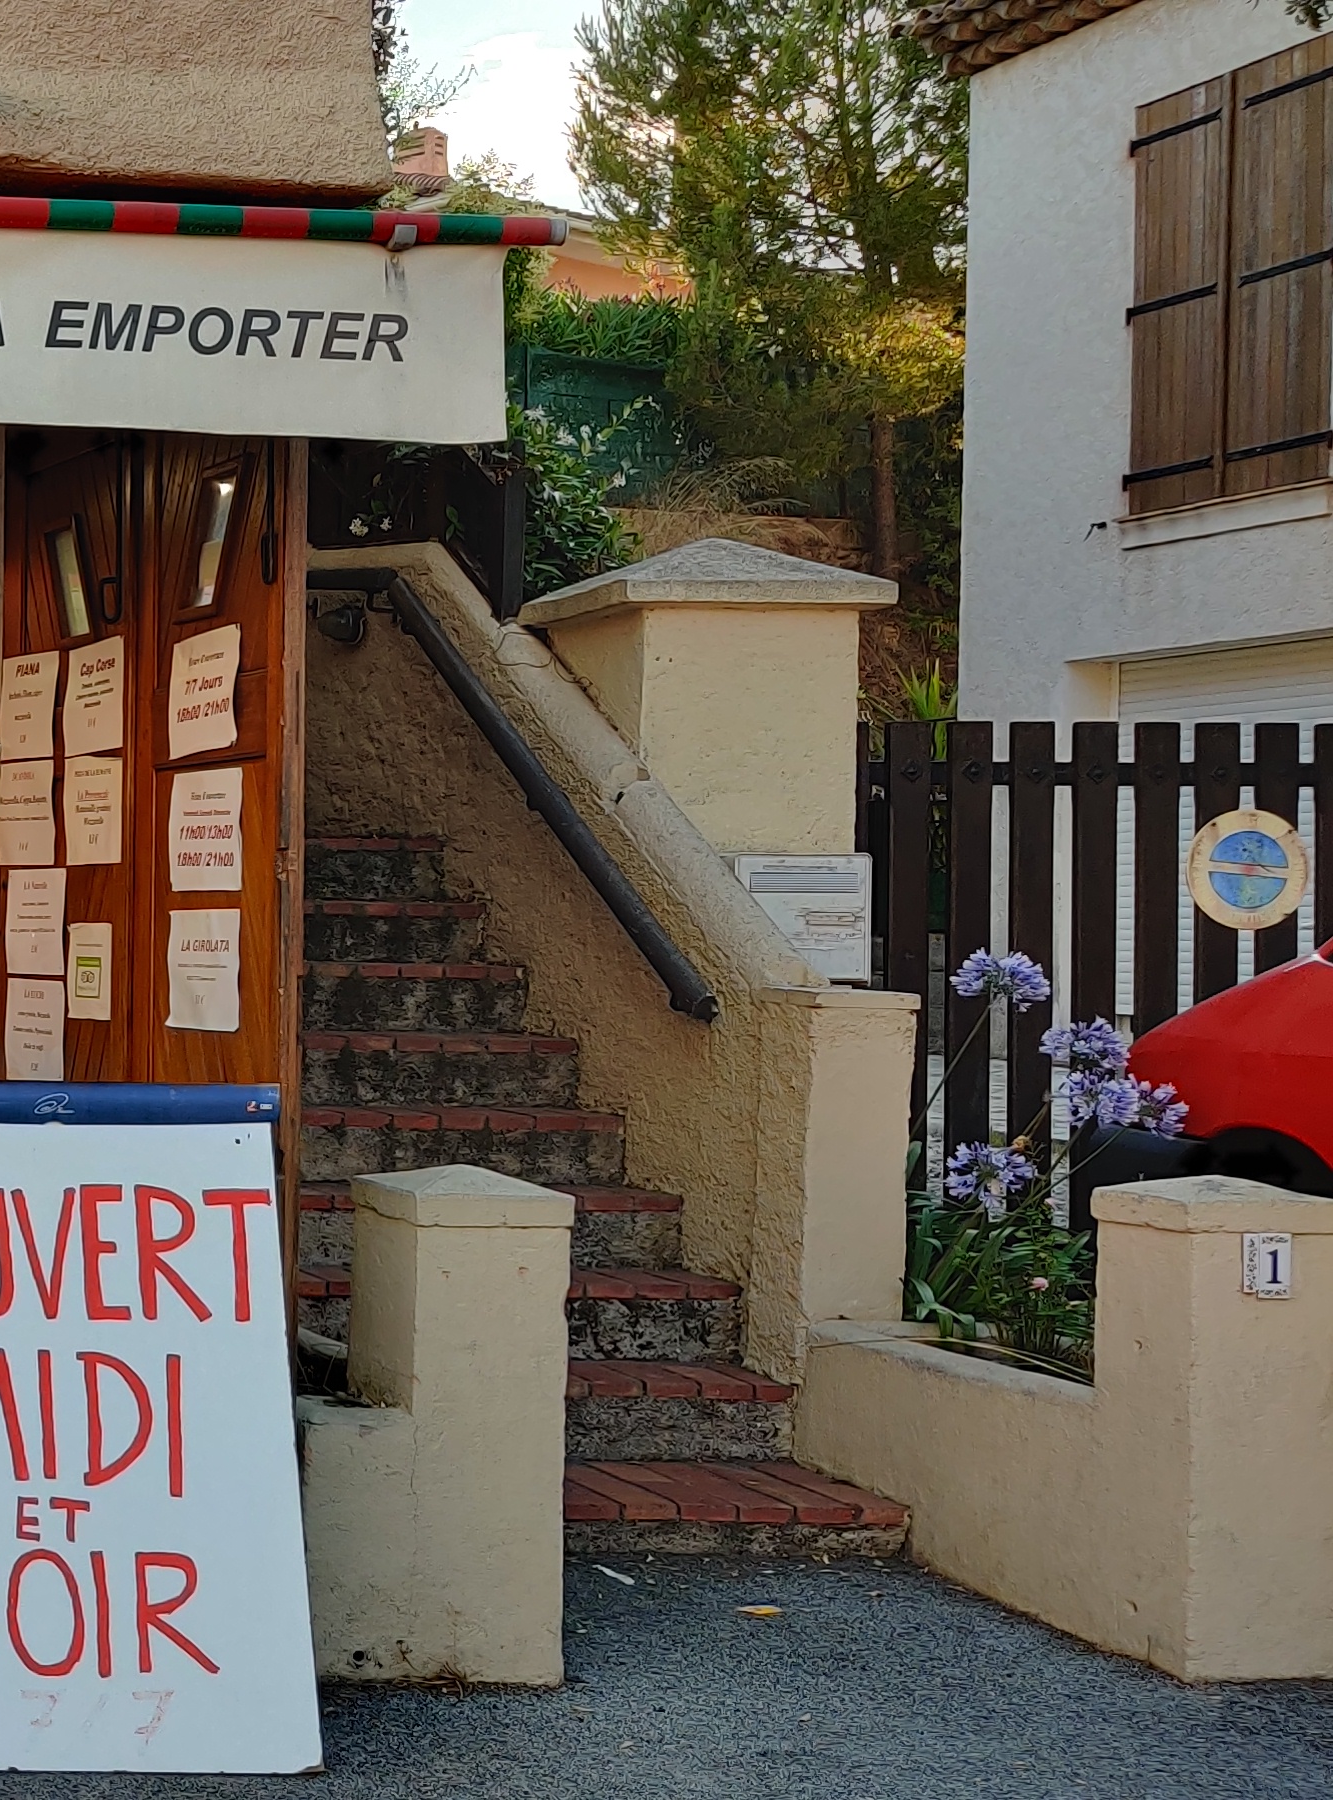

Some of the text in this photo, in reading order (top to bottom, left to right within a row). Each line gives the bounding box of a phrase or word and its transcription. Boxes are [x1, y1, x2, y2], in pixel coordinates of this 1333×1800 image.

[44, 300, 409, 362] EMPORTER
[15, 661, 41, 678] PIANA
[80, 657, 116, 678] Cap Corse
[184, 675, 223, 696] 7/7 Jours
[180, 939, 230, 953] LA GIROLATA
[1266, 1248, 1283, 1284] 1
[17, 1497, 91, 1542] ET
